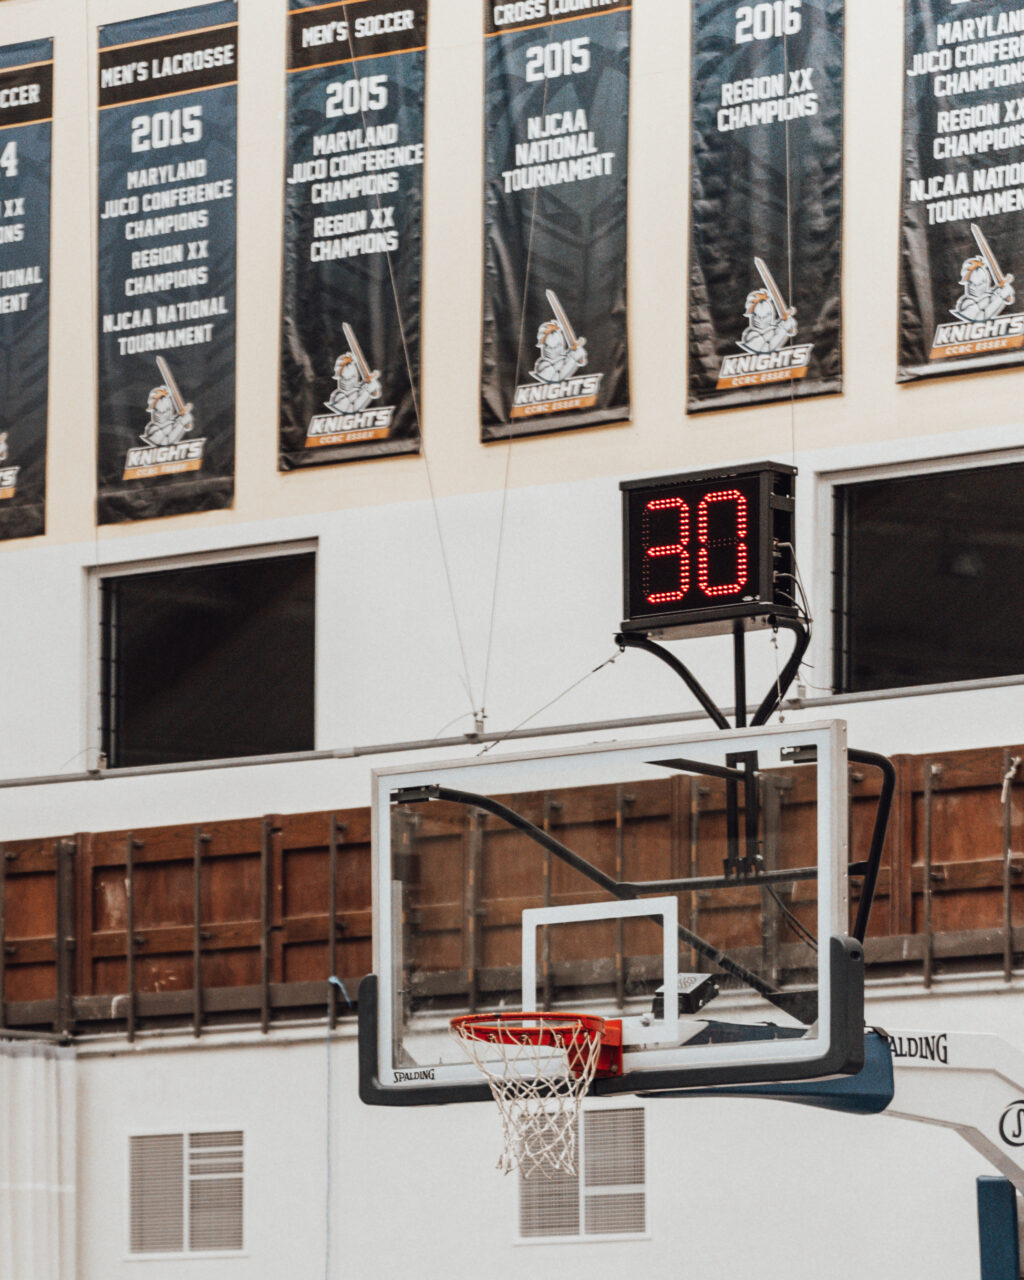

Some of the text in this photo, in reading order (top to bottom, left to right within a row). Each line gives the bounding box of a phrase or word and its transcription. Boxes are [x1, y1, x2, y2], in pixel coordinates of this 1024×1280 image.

[302, 10, 415, 48] MEN'S SOCCER
[494, 0, 547, 26] CROSS
[735, 0, 802, 44] 2016
[937, 9, 1024, 46] MARYLAN
[101, 44, 234, 88] MEN'S LACROSSE
[526, 36, 590, 82] 2015
[907, 49, 952, 76] JUCO
[721, 68, 814, 106] REGION XX
[934, 61, 1024, 97] CHAMPION
[326, 74, 388, 118] 2015
[717, 92, 818, 132] CHAMPIONS
[132, 105, 202, 153] 2015
[528, 108, 588, 140] NJCAA
[937, 103, 1001, 134] REGION
[313, 124, 398, 156] MARYLAND
[515, 132, 598, 166] NATIONAL
[127, 159, 207, 190] MARYLAND
[287, 144, 424, 184] JUCO CONFERENCE
[502, 152, 615, 194] TOURNAMENT
[101, 180, 233, 219] JUCO CONFERENCE
[312, 172, 399, 204] CHAMPIONS
[910, 172, 970, 201] NJCAA
[4, 198, 26, 218] XX
[314, 206, 395, 238] REGION XX
[126, 210, 208, 240] CHAMPIONS
[132, 240, 208, 270] REGION XX
[310, 230, 398, 262] CHAMPIONS
[125, 266, 208, 296] CHAMPIONS
[103, 297, 228, 332] NJCAA NATIONAL
[118, 324, 214, 356] TOURNAMENT
[937, 316, 1024, 346] KNIGHTS
[723, 348, 809, 377] KNIGHTS
[945, 340, 1008, 356] CCBC ESSEX
[514, 374, 598, 404] KNIGHTS
[760, 370, 792, 382] ESSEX
[311, 408, 392, 436] KNIGHTS
[127, 440, 204, 466] KNIGHTS
[646, 489, 748, 604] 30
[890, 1034, 948, 1064] ALDING
[394, 1068, 434, 1084] SPALDING
